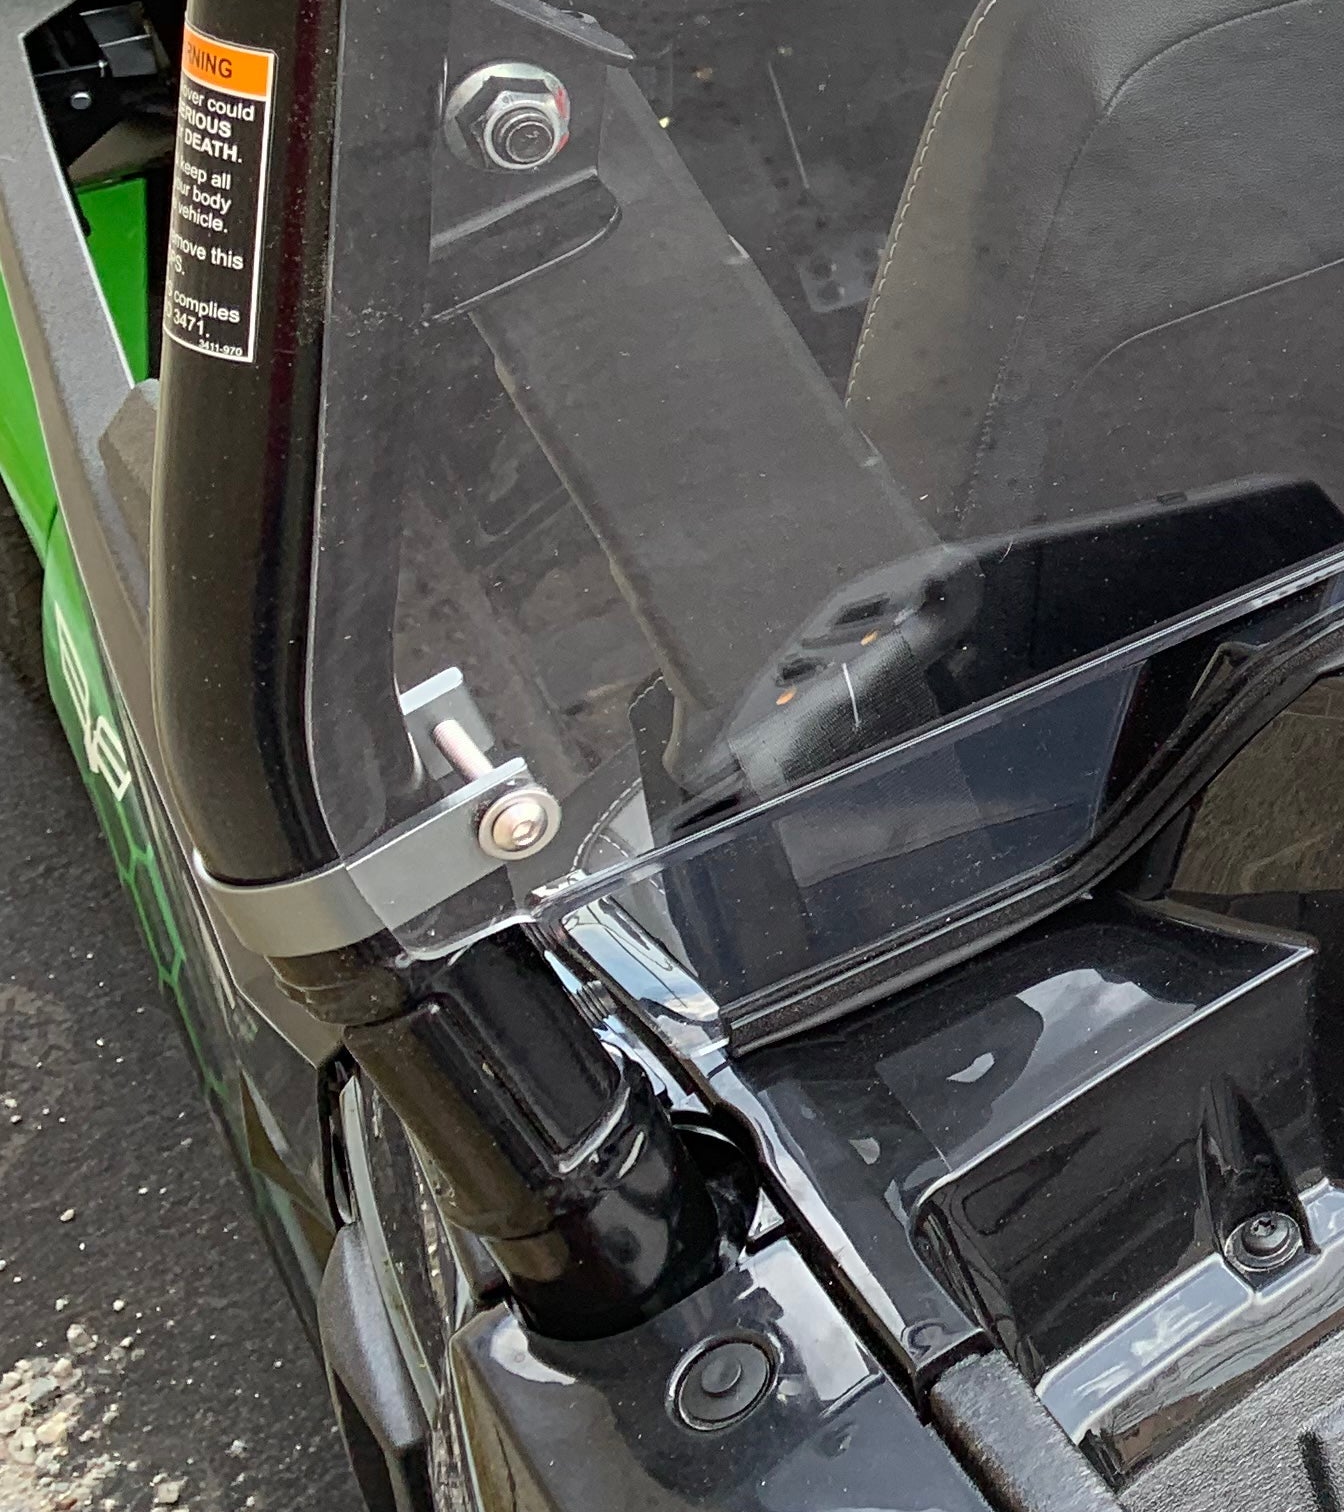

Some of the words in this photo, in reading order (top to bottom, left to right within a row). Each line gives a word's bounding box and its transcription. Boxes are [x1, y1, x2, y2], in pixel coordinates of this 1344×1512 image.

[207, 98, 255, 122] could
[184, 128, 243, 164] DEATH.
[180, 156, 208, 185] keep
[211, 173, 231, 190] all
[192, 185, 232, 215] body
[178, 202, 228, 233] vehicle.
[211, 247, 244, 270] this
[173, 290, 241, 323] complies
[173, 308, 210, 338] 3471.
[198, 338, 244, 357] 3411-970
